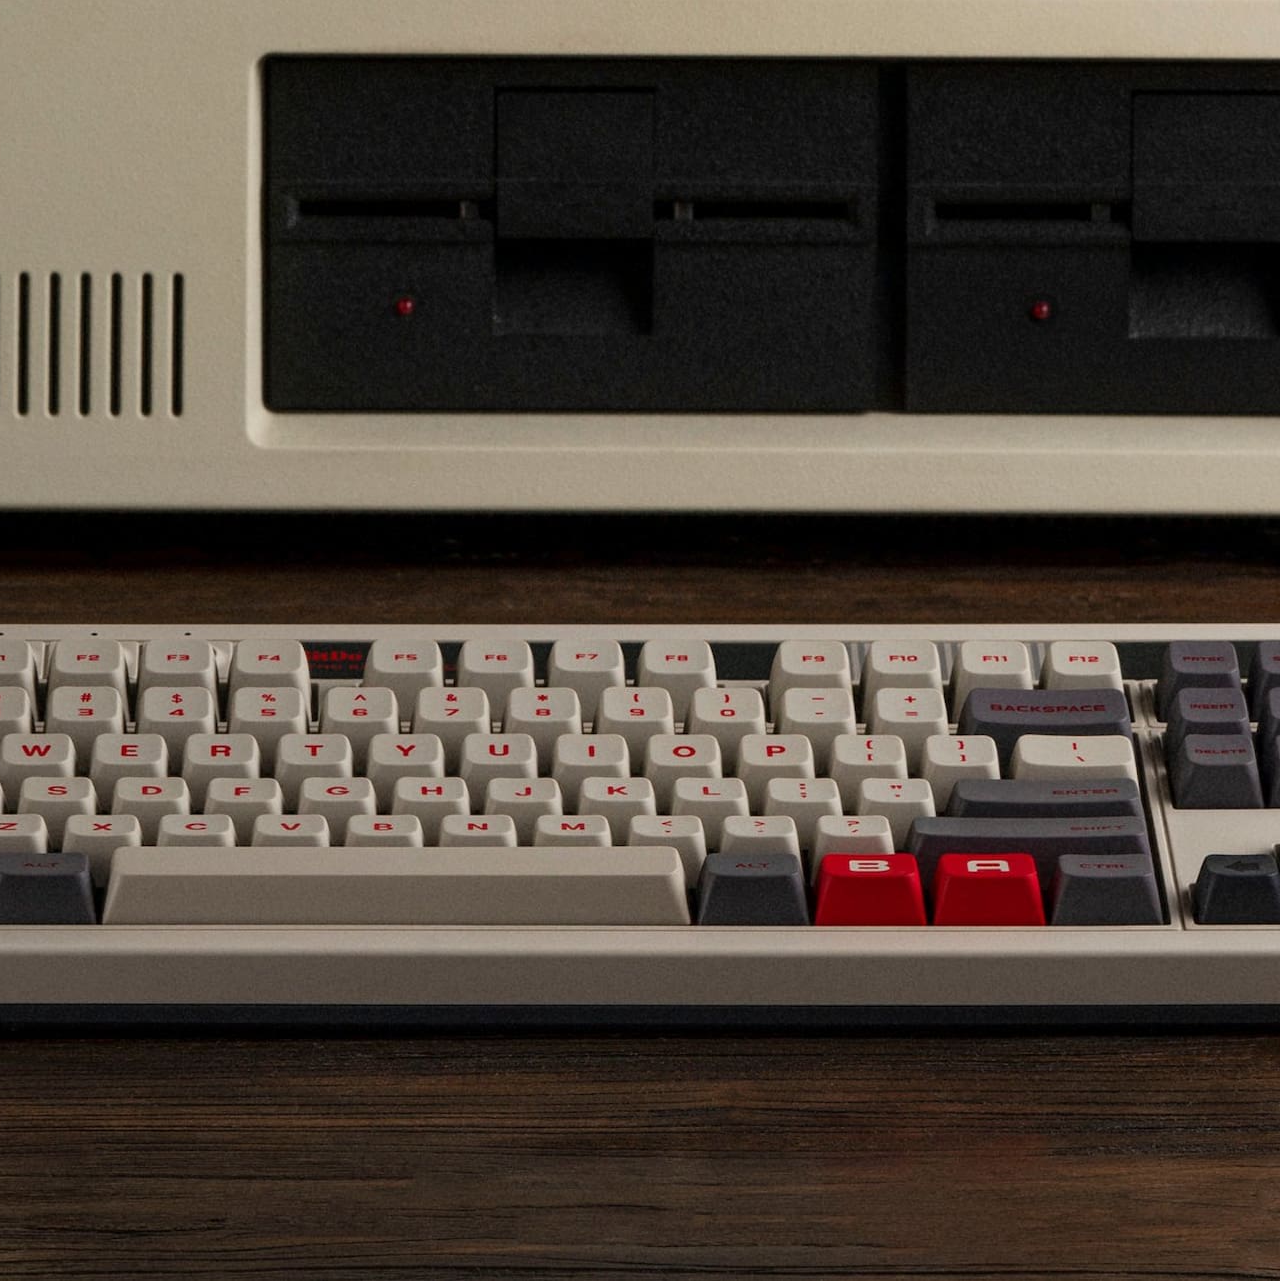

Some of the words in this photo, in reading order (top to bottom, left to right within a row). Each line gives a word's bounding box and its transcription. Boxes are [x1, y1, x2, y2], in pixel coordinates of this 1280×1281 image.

[801, 655, 825, 663] F9
[1068, 655, 1099, 663] F12
[80, 708, 93, 716] 3
[261, 708, 275, 716] 5
[352, 708, 368, 716] 6
[445, 708, 460, 716] 7
[535, 708, 550, 716] 8
[720, 709, 735, 717] 0
[992, 703, 1105, 713] BACKSPACE
[22, 745, 50, 756] W
[120, 744, 138, 757] E
[210, 745, 231, 756] R
[305, 744, 324, 757] T
[396, 744, 416, 757] Y
[489, 744, 510, 757] U
[588, 745, 595, 757] I
[673, 745, 696, 758] O
[767, 746, 785, 757] P
[47, 785, 67, 796] S
[141, 786, 162, 795] D
[234, 786, 252, 796] F
[325, 786, 349, 796] G
[420, 786, 443, 795] H
[515, 786, 532, 797] J
[608, 786, 628, 796] K
[703, 786, 721, 796] L
[94, 823, 111, 831] X
[185, 822, 207, 831] C
[373, 823, 393, 831] B
[848, 859, 890, 872] B
[967, 859, 1011, 872] A
